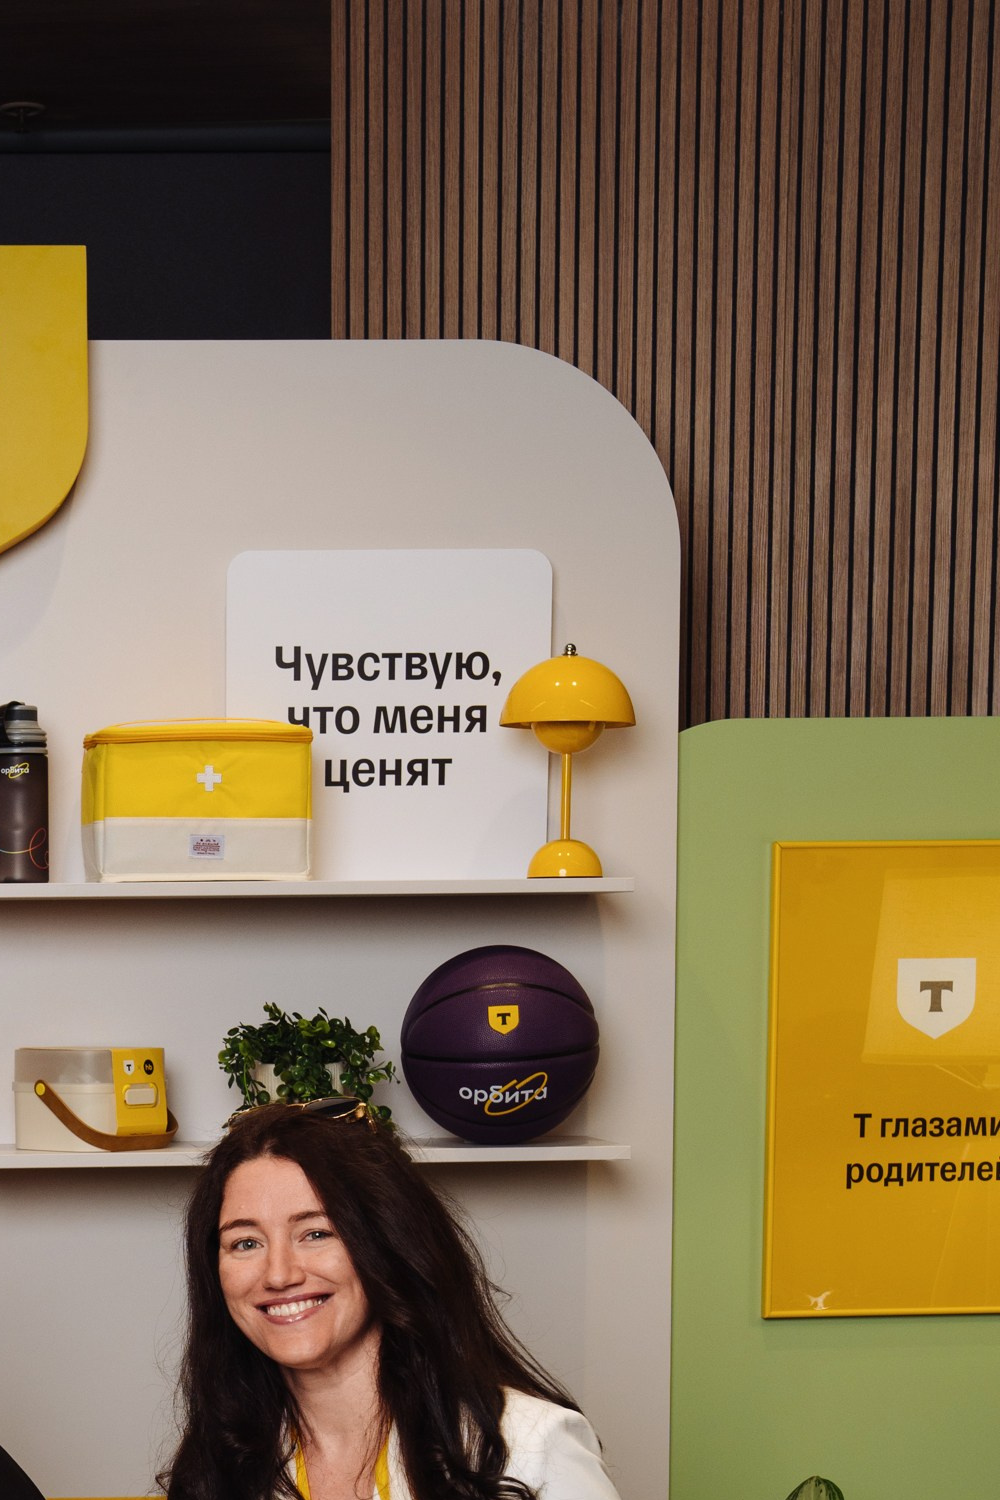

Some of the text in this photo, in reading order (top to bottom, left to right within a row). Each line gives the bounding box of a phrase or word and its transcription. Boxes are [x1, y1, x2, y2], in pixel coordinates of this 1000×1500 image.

[275, 645, 502, 691] Чувствую,
[288, 705, 487, 735] что меня
[324, 758, 453, 793] ценят
[919, 980, 954, 1013] Т
[496, 1012, 511, 1026] Т
[853, 1113, 873, 1138] Т
[846, 1160, 1000, 1190] родителе
